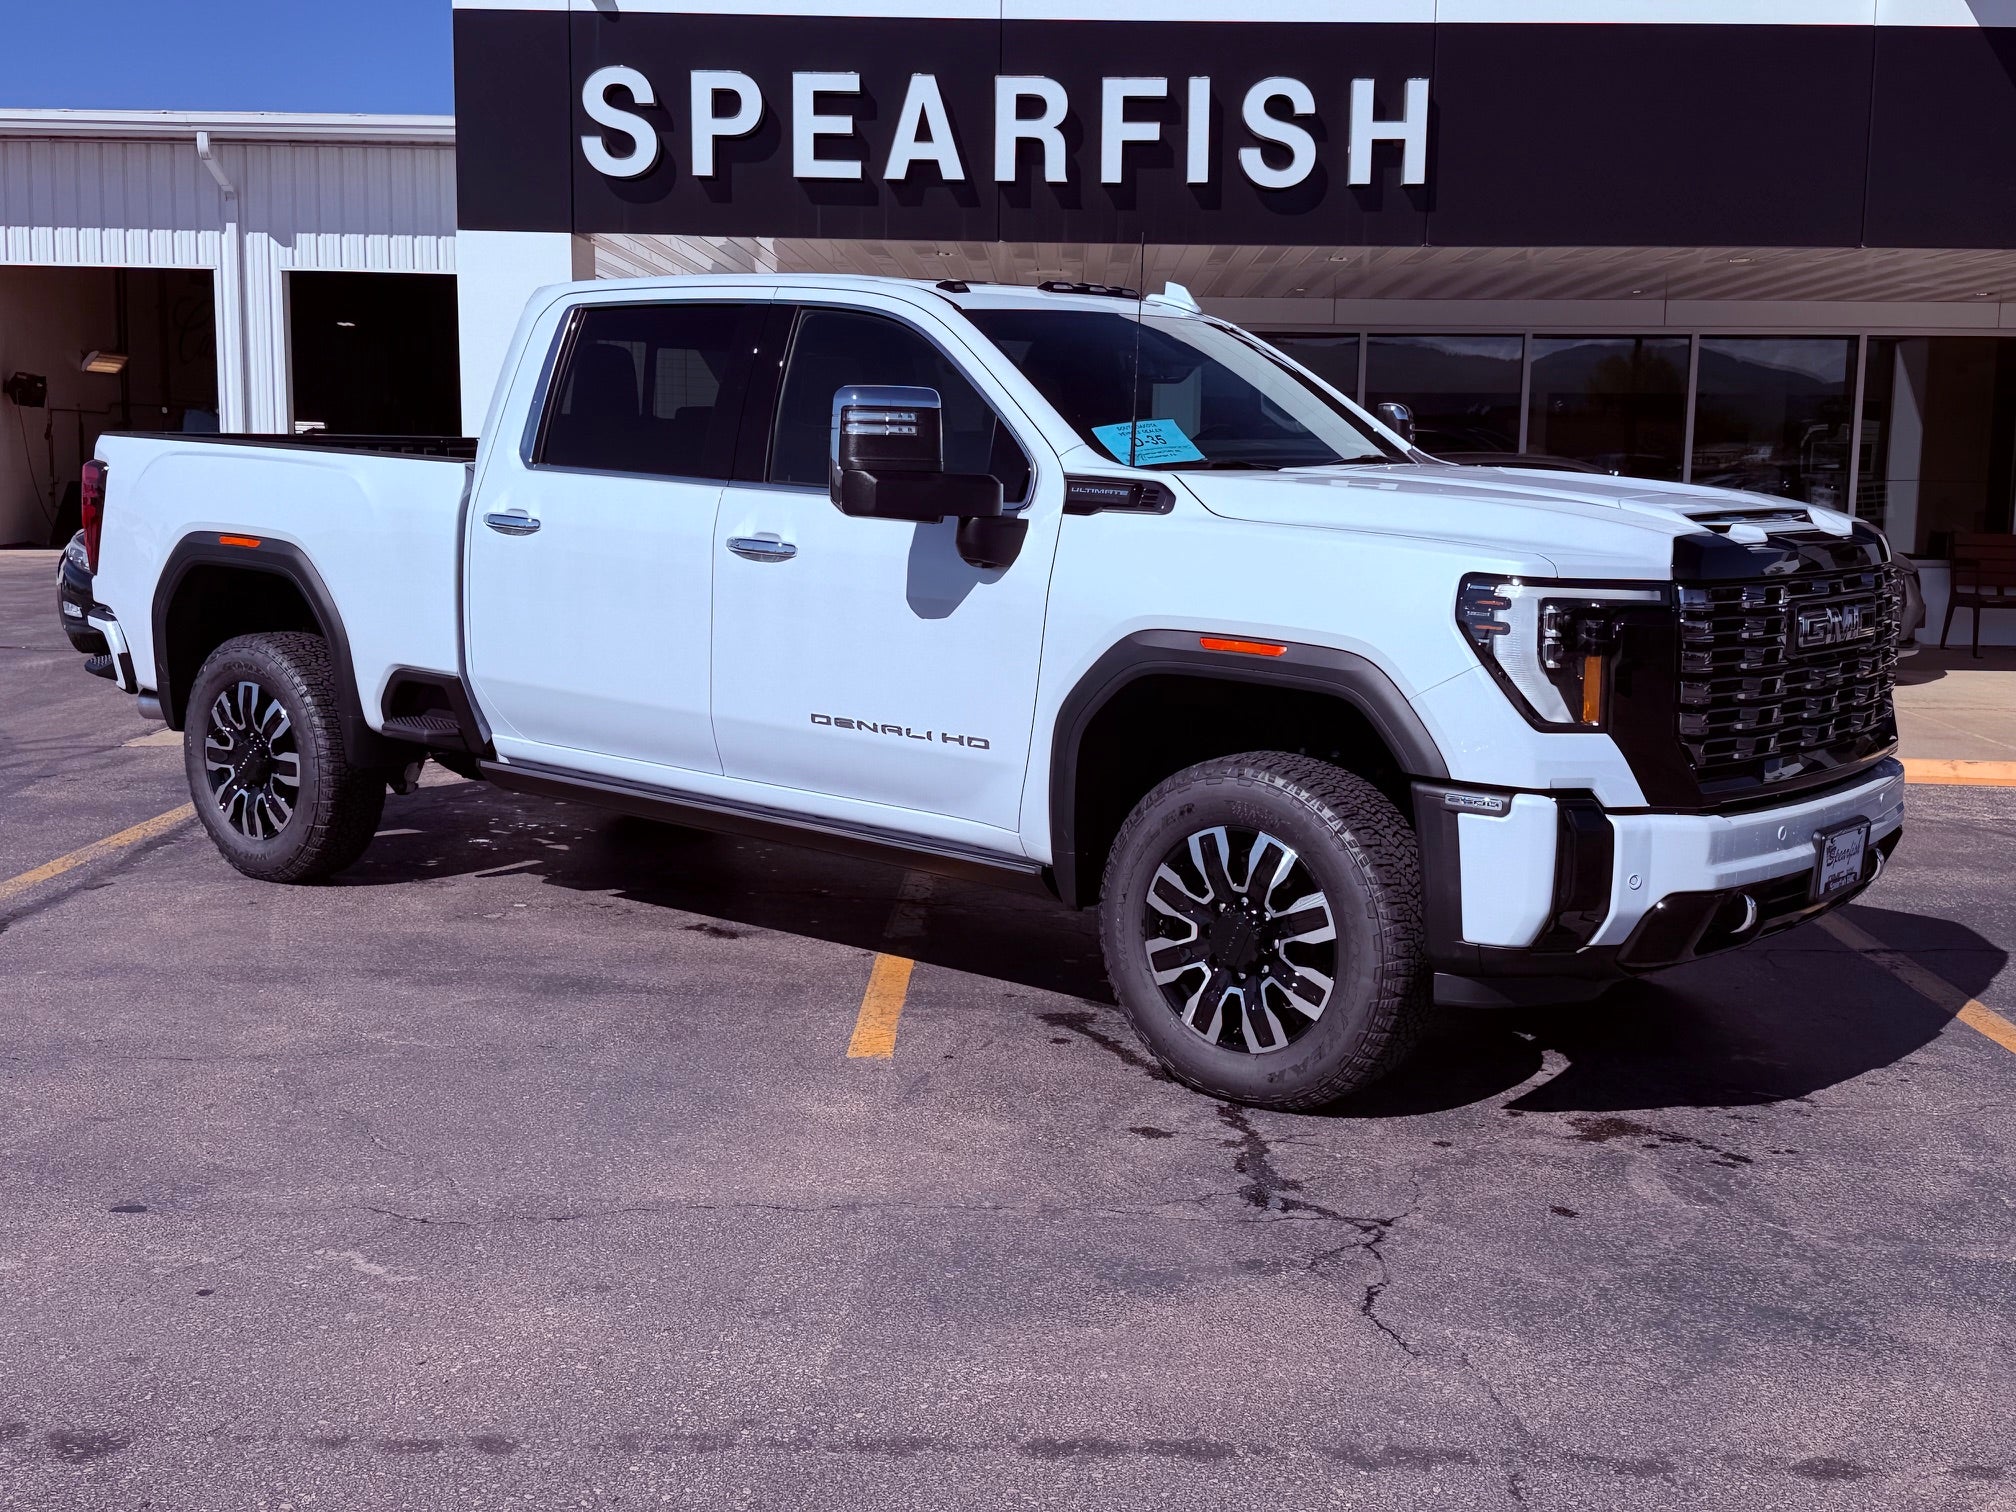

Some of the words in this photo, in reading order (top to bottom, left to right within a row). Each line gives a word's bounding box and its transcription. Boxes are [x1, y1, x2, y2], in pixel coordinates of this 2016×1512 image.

[580, 65, 1430, 190] SPEARFISH
[1071, 487, 1129, 496] ULTIMATE
[1798, 603, 1876, 647] GMC
[810, 713, 932, 741] DENALI
[941, 732, 990, 750] HD
